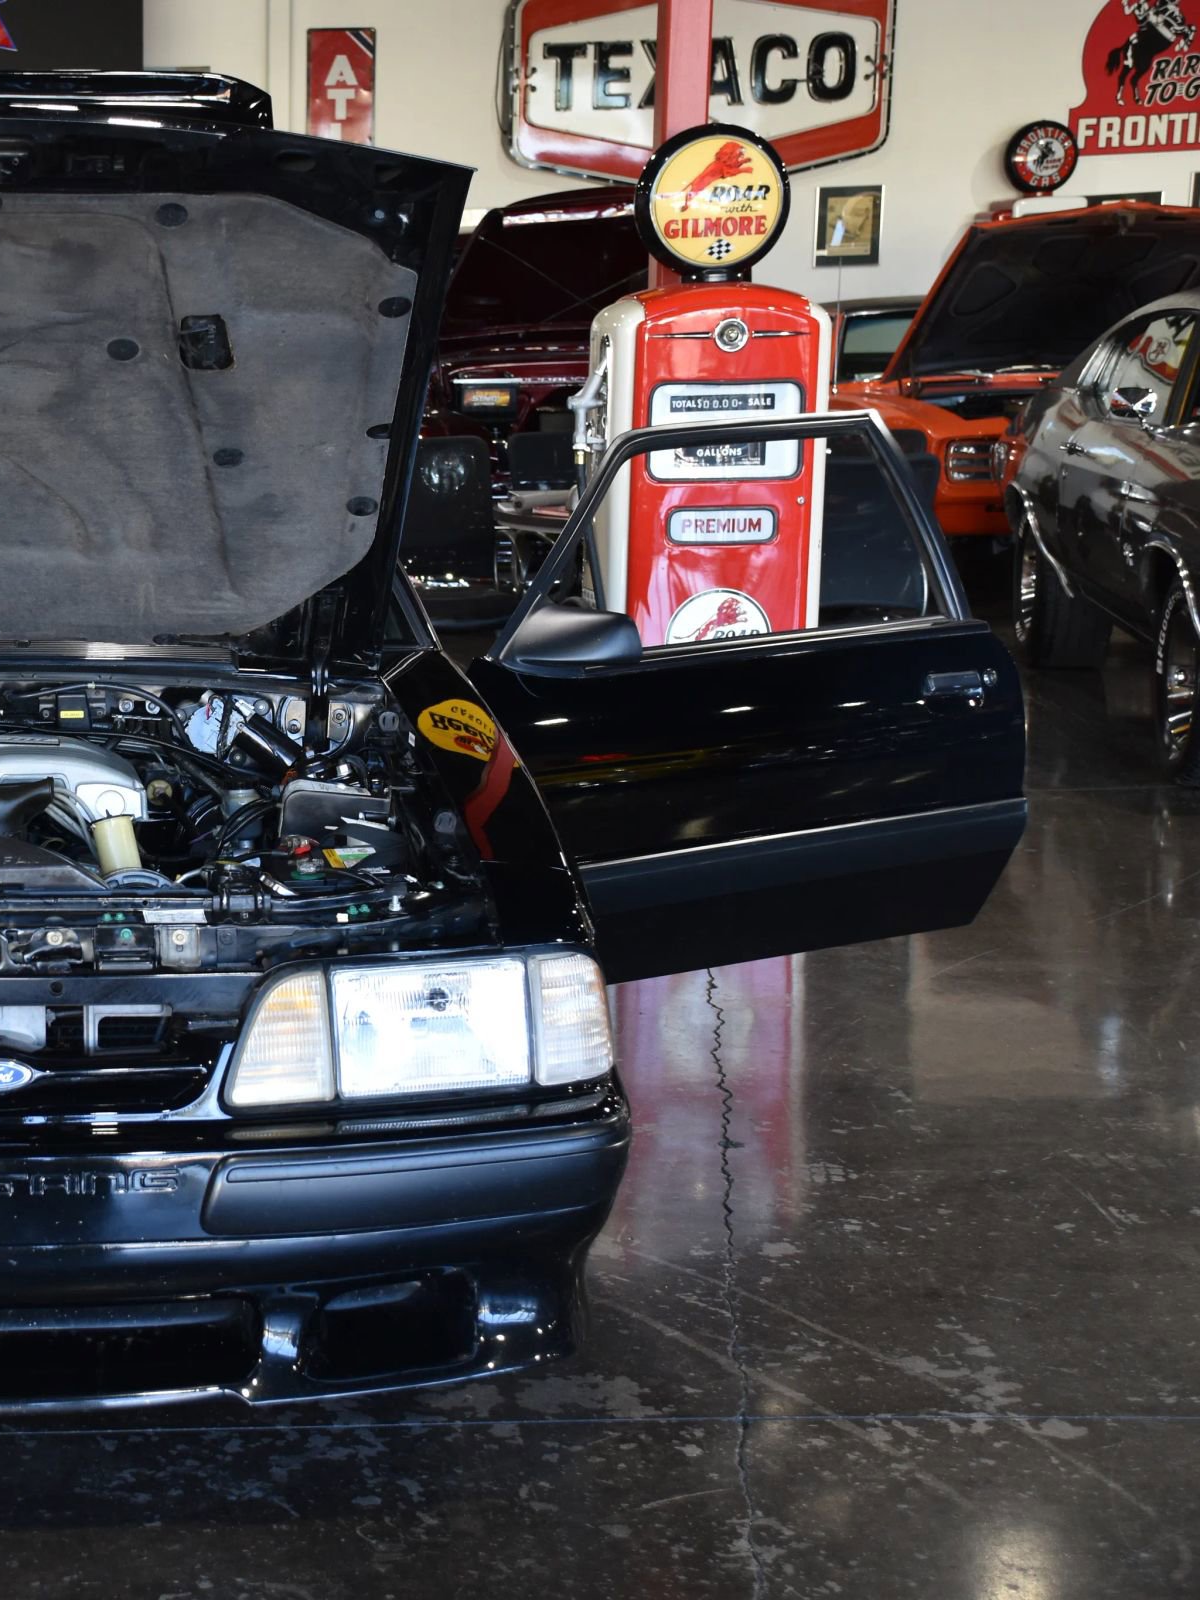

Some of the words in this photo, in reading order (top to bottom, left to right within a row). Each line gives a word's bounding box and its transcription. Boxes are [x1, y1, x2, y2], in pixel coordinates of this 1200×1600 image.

[721, 203, 758, 213] with
[663, 214, 768, 240] GILMORE
[672, 400, 696, 409] TOTAL
[748, 397, 772, 406] SALE
[696, 448, 742, 457] GALLONS
[681, 517, 762, 534] PREMIUM
